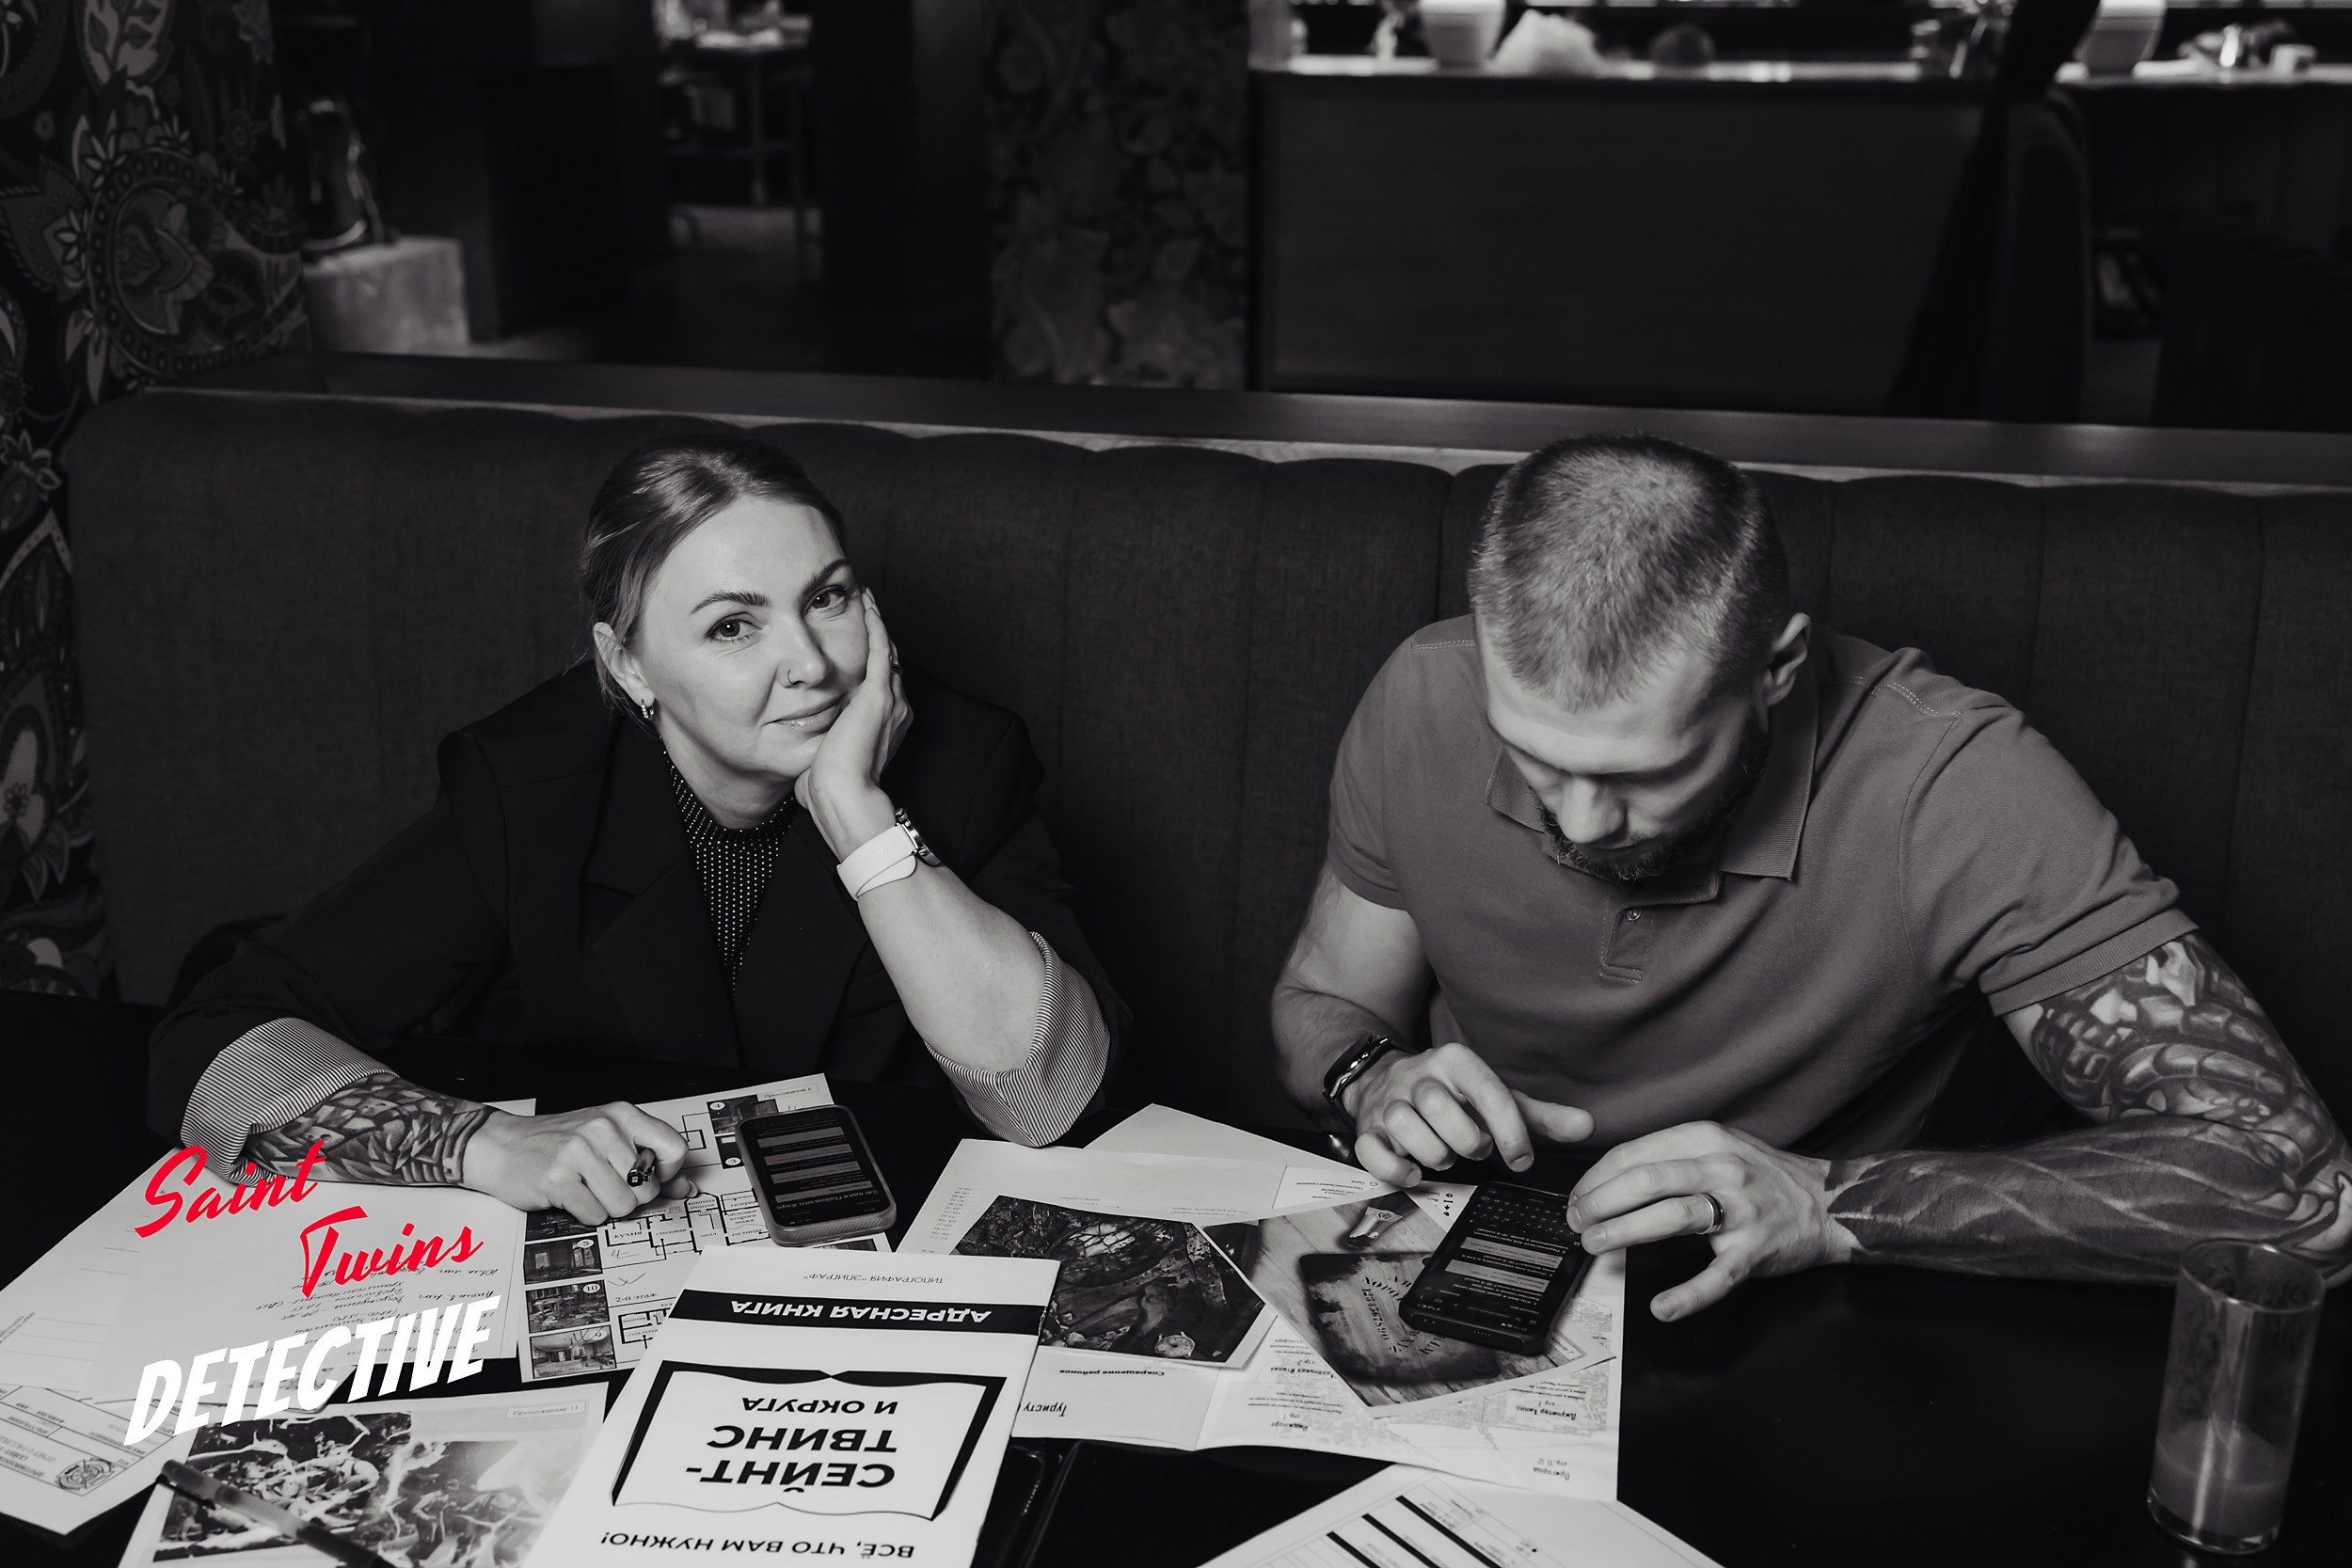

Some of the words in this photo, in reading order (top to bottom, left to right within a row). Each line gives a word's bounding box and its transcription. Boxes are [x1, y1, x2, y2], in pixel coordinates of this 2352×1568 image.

[868, 1275, 945, 1285] ТИПОГРАФИЯ
[730, 1301, 825, 1318] КНИГА
[831, 1304, 993, 1324] АДРЕСНАЯ
[513, 1407, 567, 1417] Приложение
[741, 1397, 866, 1415] ОКРУГА
[876, 1400, 899, 1415] И
[1024, 1402, 1068, 1418] Туристу
[706, 1426, 898, 1454] ТВИНС
[686, 1460, 896, 1493] СЕЙНТ-
[601, 1529, 714, 1551] НУЖНО!
[720, 1538, 784, 1553] ВАМ
[790, 1540, 846, 1556] ЧТО
[856, 1541, 915, 1560] ВСЁ,
